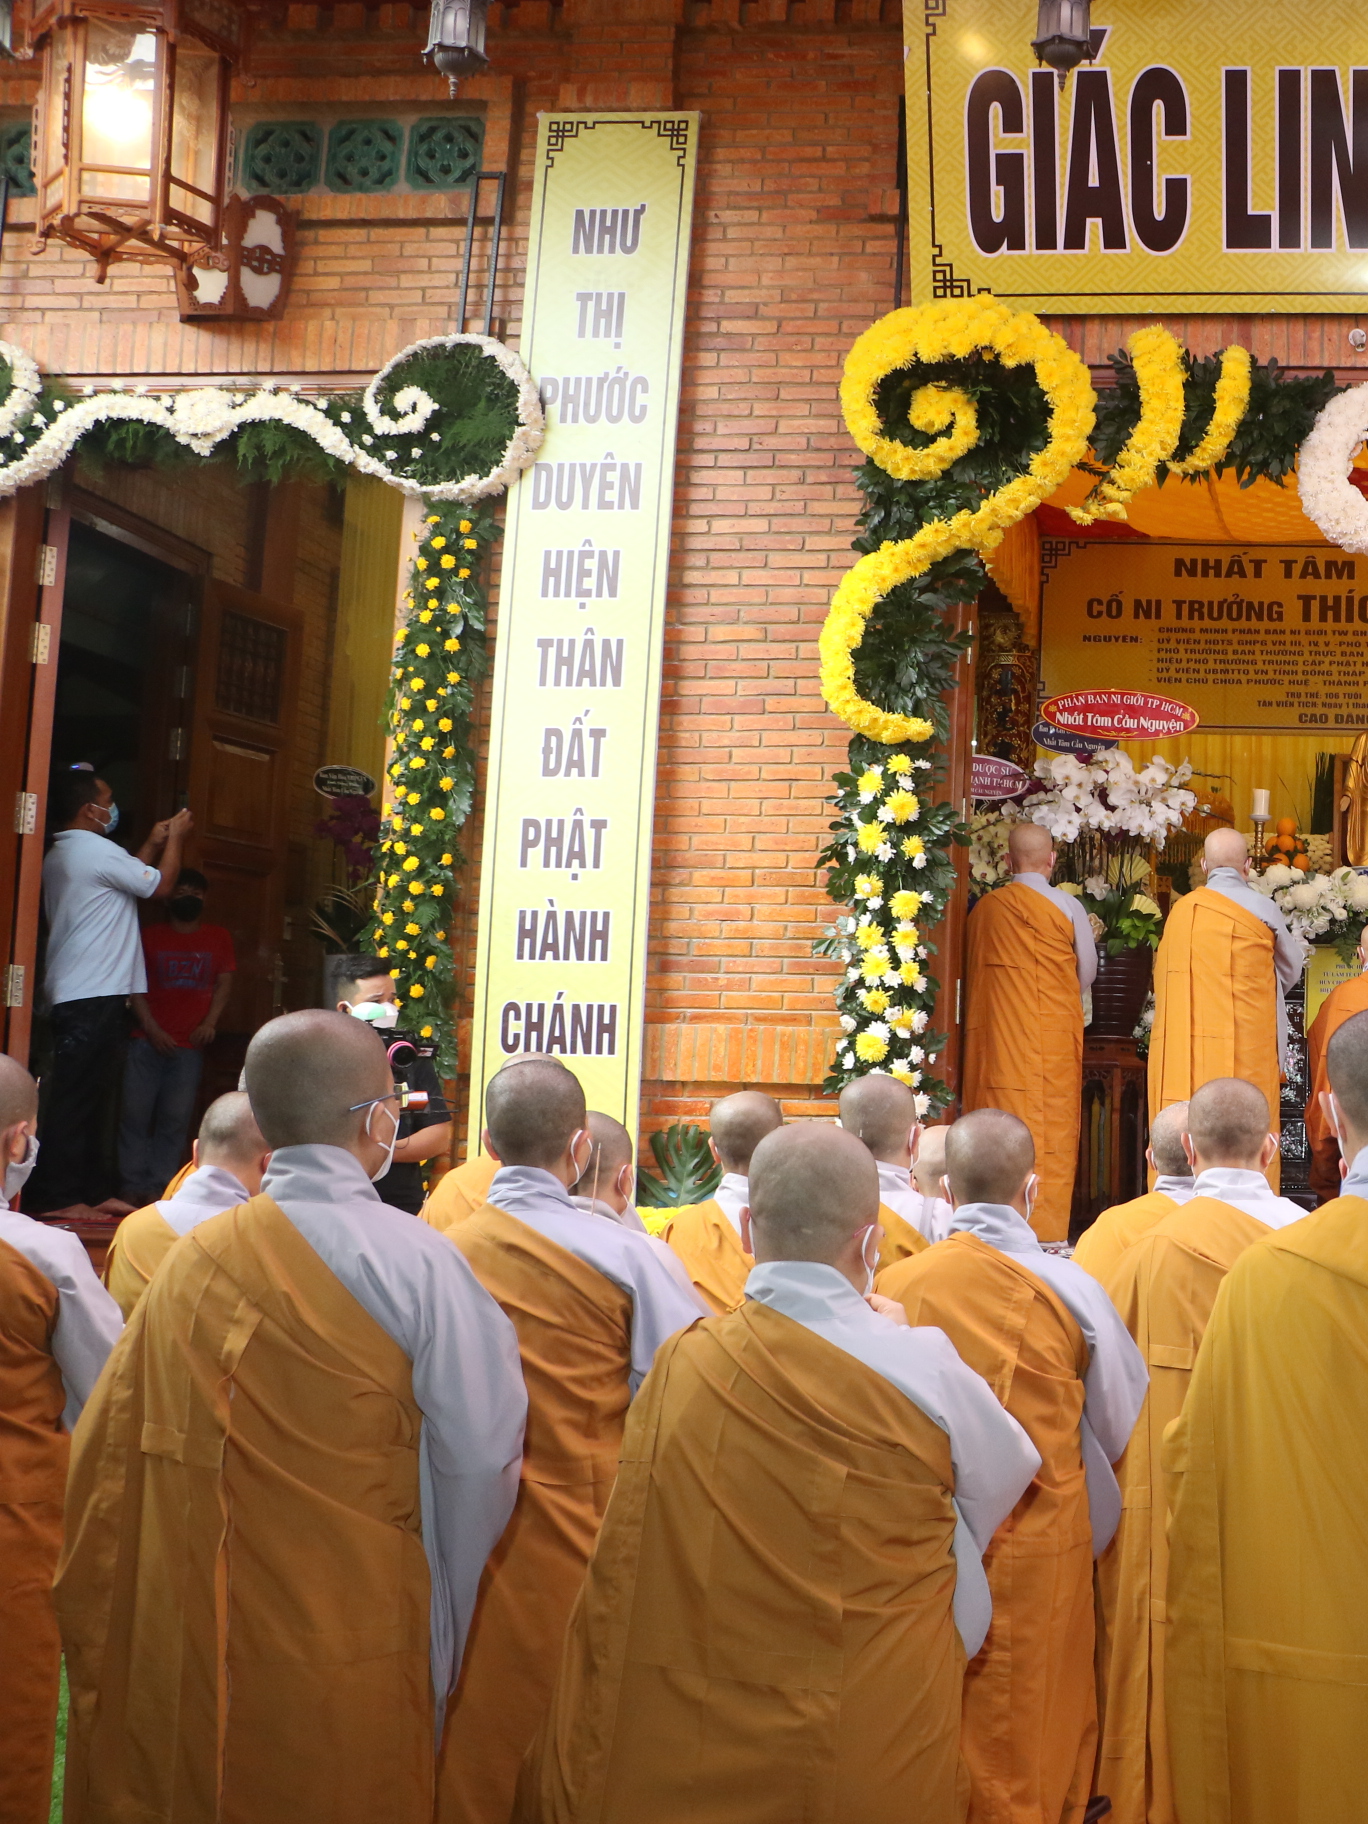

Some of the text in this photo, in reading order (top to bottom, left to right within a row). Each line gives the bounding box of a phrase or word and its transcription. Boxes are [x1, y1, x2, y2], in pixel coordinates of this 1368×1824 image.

[965, 25, 1191, 254] GIÁC
[1174, 552, 1268, 578] NHẤT
[1279, 555, 1355, 580] TÂM
[1087, 591, 1124, 620] CỐ
[1133, 599, 1161, 620] NI
[1172, 593, 1283, 622] TRƯỞNG
[501, 204, 649, 1055] NHƯ THỊ PHƯỚC DUYÊN HIỆN THÂN ĐẤT PHẬT HÀNH CHÁNH
[1058, 693, 1184, 716] PHÂN BAN NI GIỚI TP HCM
[1055, 710, 1184, 732] Nhất Tâm Cầu Nguyện
[1298, 713, 1328, 724] CAO
[972, 762, 1000, 776] DƯỢC
